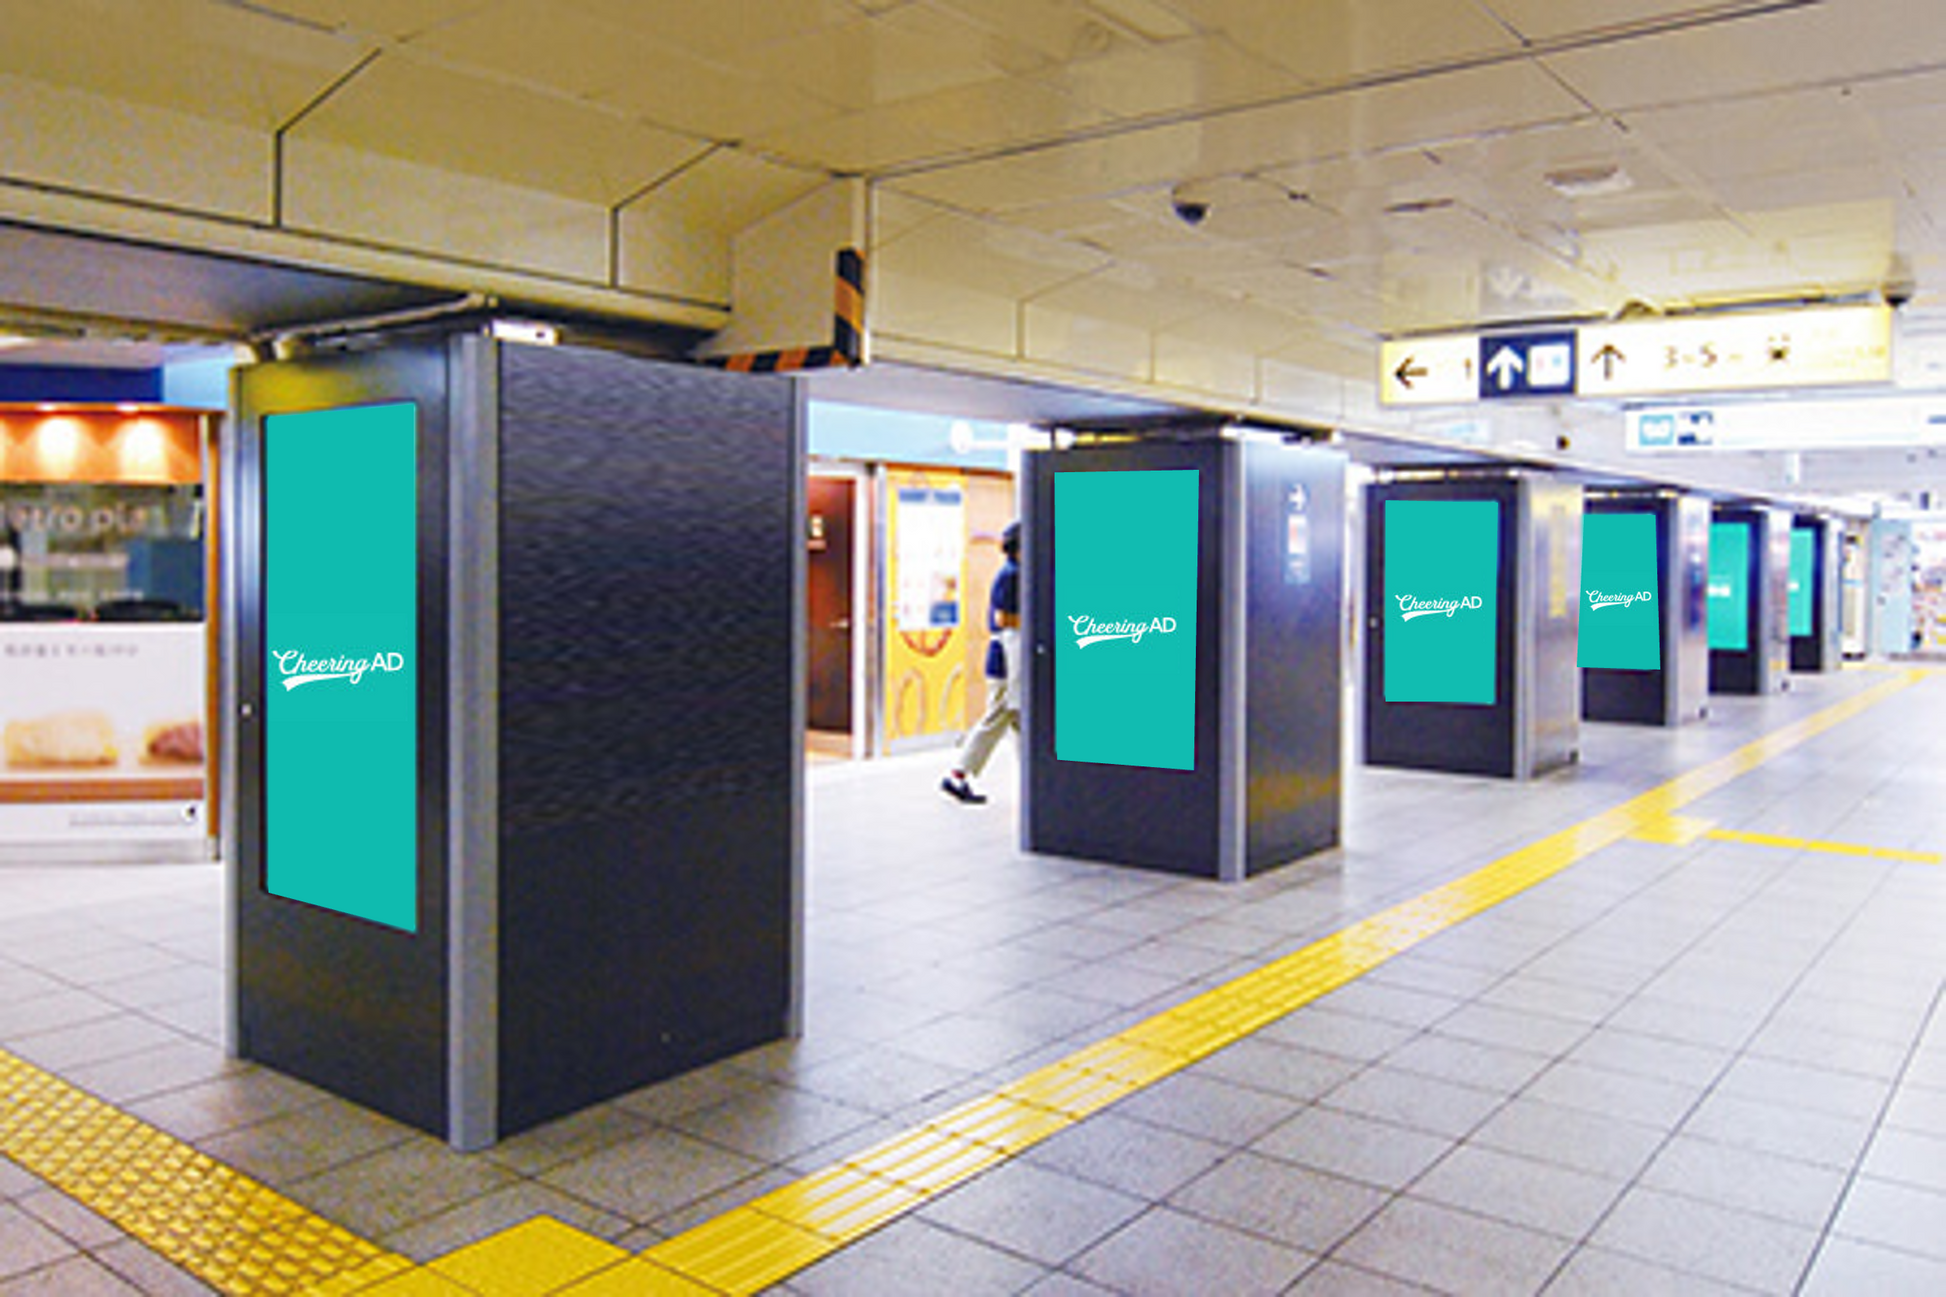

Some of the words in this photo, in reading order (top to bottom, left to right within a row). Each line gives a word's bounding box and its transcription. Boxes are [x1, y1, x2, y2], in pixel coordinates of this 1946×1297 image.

[1396, 595, 1460, 618] Cheering
[1459, 595, 1483, 609] AD
[1586, 591, 1635, 608] Cheering
[1634, 591, 1652, 602] AD
[1068, 615, 1148, 645] Cheering
[1148, 617, 1177, 633] AD
[272, 650, 370, 686] Cheering
[370, 652, 404, 672] AD
